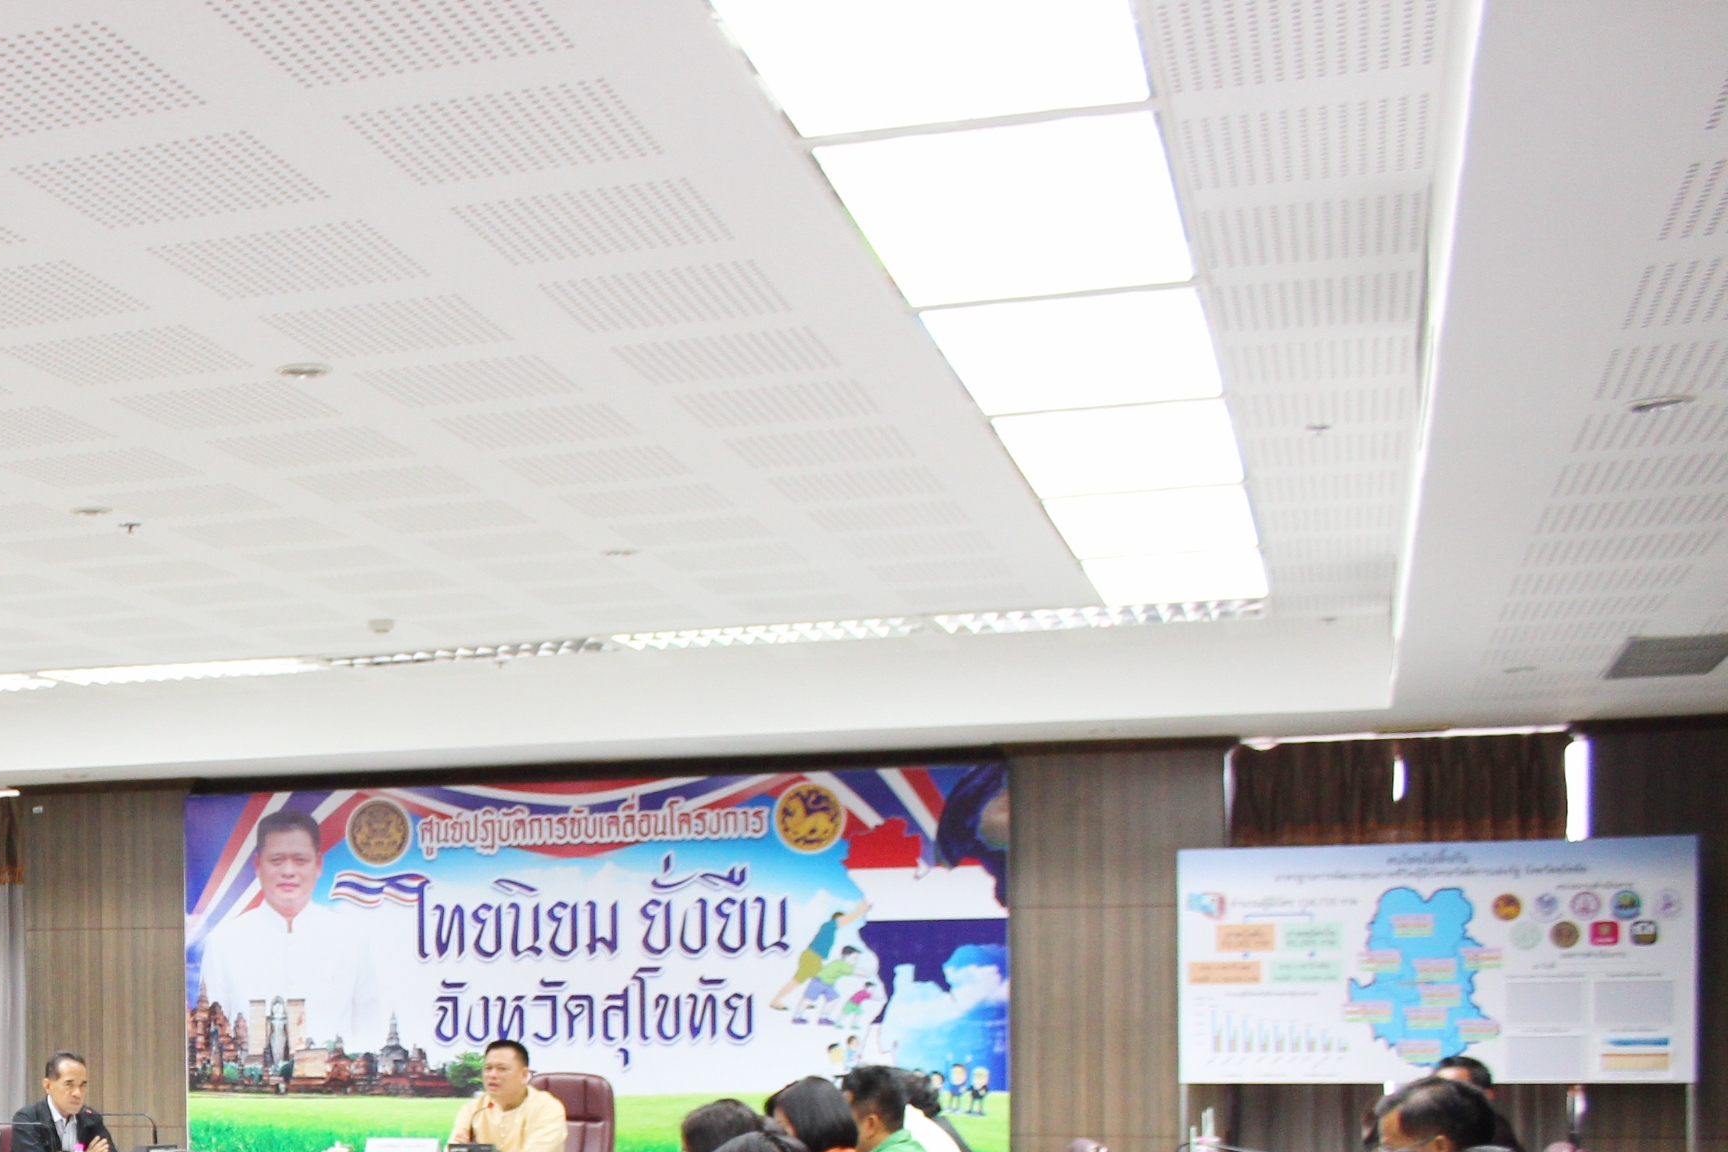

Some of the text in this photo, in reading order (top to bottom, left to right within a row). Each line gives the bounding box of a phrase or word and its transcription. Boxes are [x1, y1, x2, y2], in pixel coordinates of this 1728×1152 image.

[420, 794, 766, 856] ศูนย์ปฏิบัติการขับเคลื่อนโครงการ
[416, 854, 791, 959] ไทยนิยม ยั่งยืน
[434, 966, 754, 1068] จังหวัดสุโขทัย
